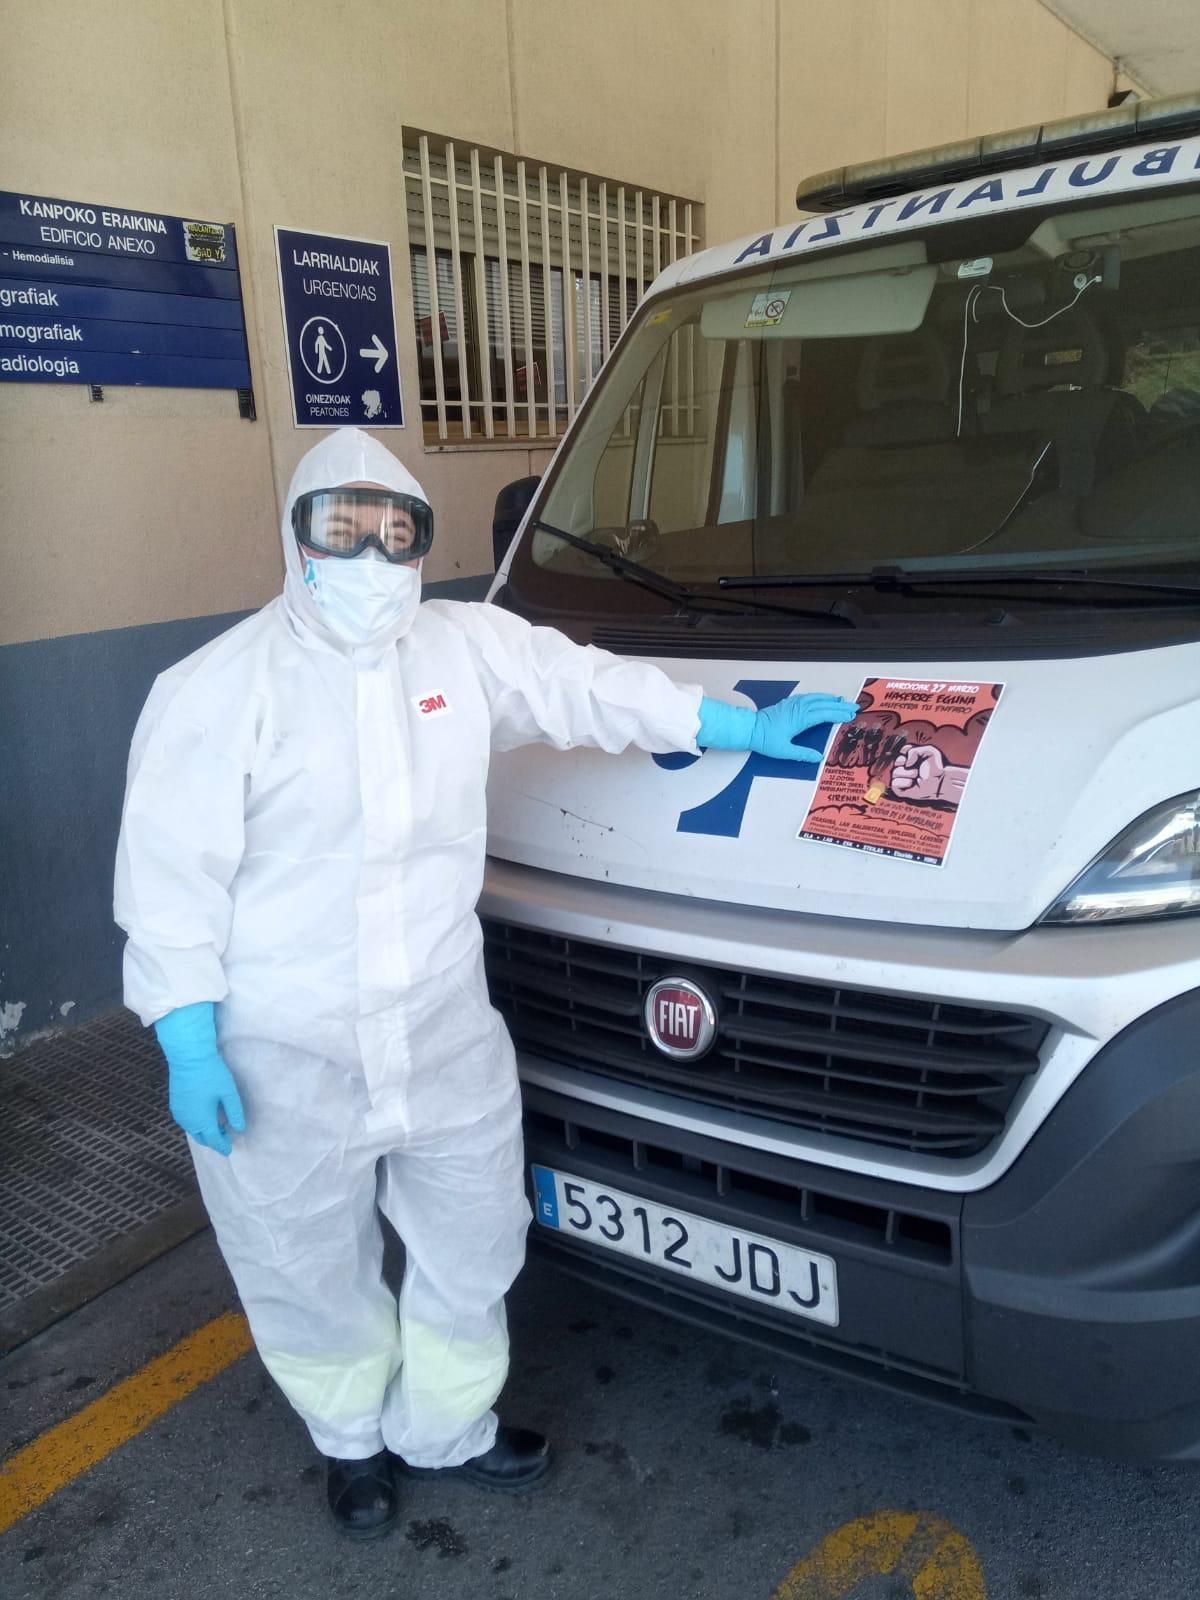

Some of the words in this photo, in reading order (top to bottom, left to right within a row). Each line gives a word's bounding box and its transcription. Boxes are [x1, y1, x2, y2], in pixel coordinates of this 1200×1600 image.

[20, 199, 96, 224] KANPOKO
[102, 212, 167, 234] ERAIKINA
[40, 226, 102, 248] EDIFICIO
[108, 236, 155, 254] ANEXO
[12, 250, 74, 266] Hemodialisia
[293, 250, 380, 276] LARRIALDIAK
[303, 278, 377, 302] URGENCIAS
[0, 354, 80, 376] adiologia
[306, 393, 351, 404] OINEZKOAK
[310, 402, 349, 417] PEATONES
[884, 692, 934, 702] HASERRE
[936, 694, 976, 704] EGUNA
[931, 684, 946, 693] 27
[948, 685, 980, 693] MARZO
[419, 694, 446, 713] 3M
[659, 1000, 698, 1039] FIAT
[544, 1203, 553, 1216] E
[563, 1181, 692, 1269] 5312
[714, 1237, 821, 1309] JDJ
